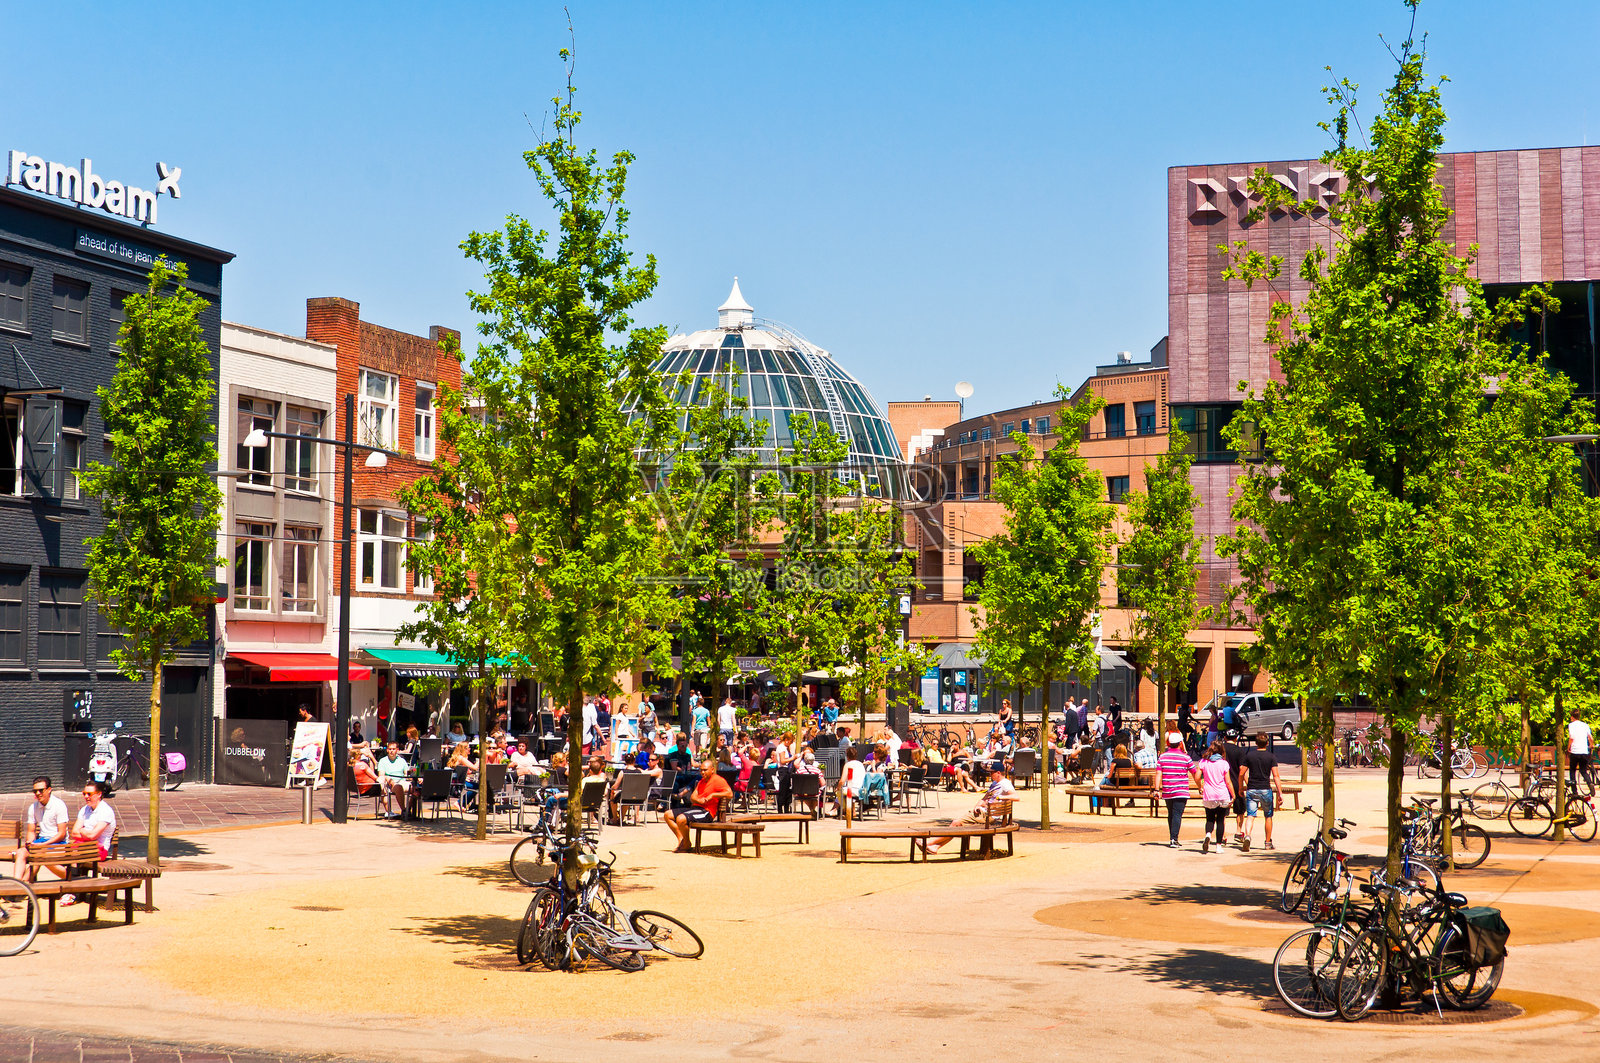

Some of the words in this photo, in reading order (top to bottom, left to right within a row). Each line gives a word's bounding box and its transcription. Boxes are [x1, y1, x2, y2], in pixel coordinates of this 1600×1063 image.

[8, 149, 158, 224] rambam
[79, 233, 107, 251] ahead
[109, 241, 118, 254] of
[120, 244, 133, 259] the
[134, 248, 153, 263] jean
